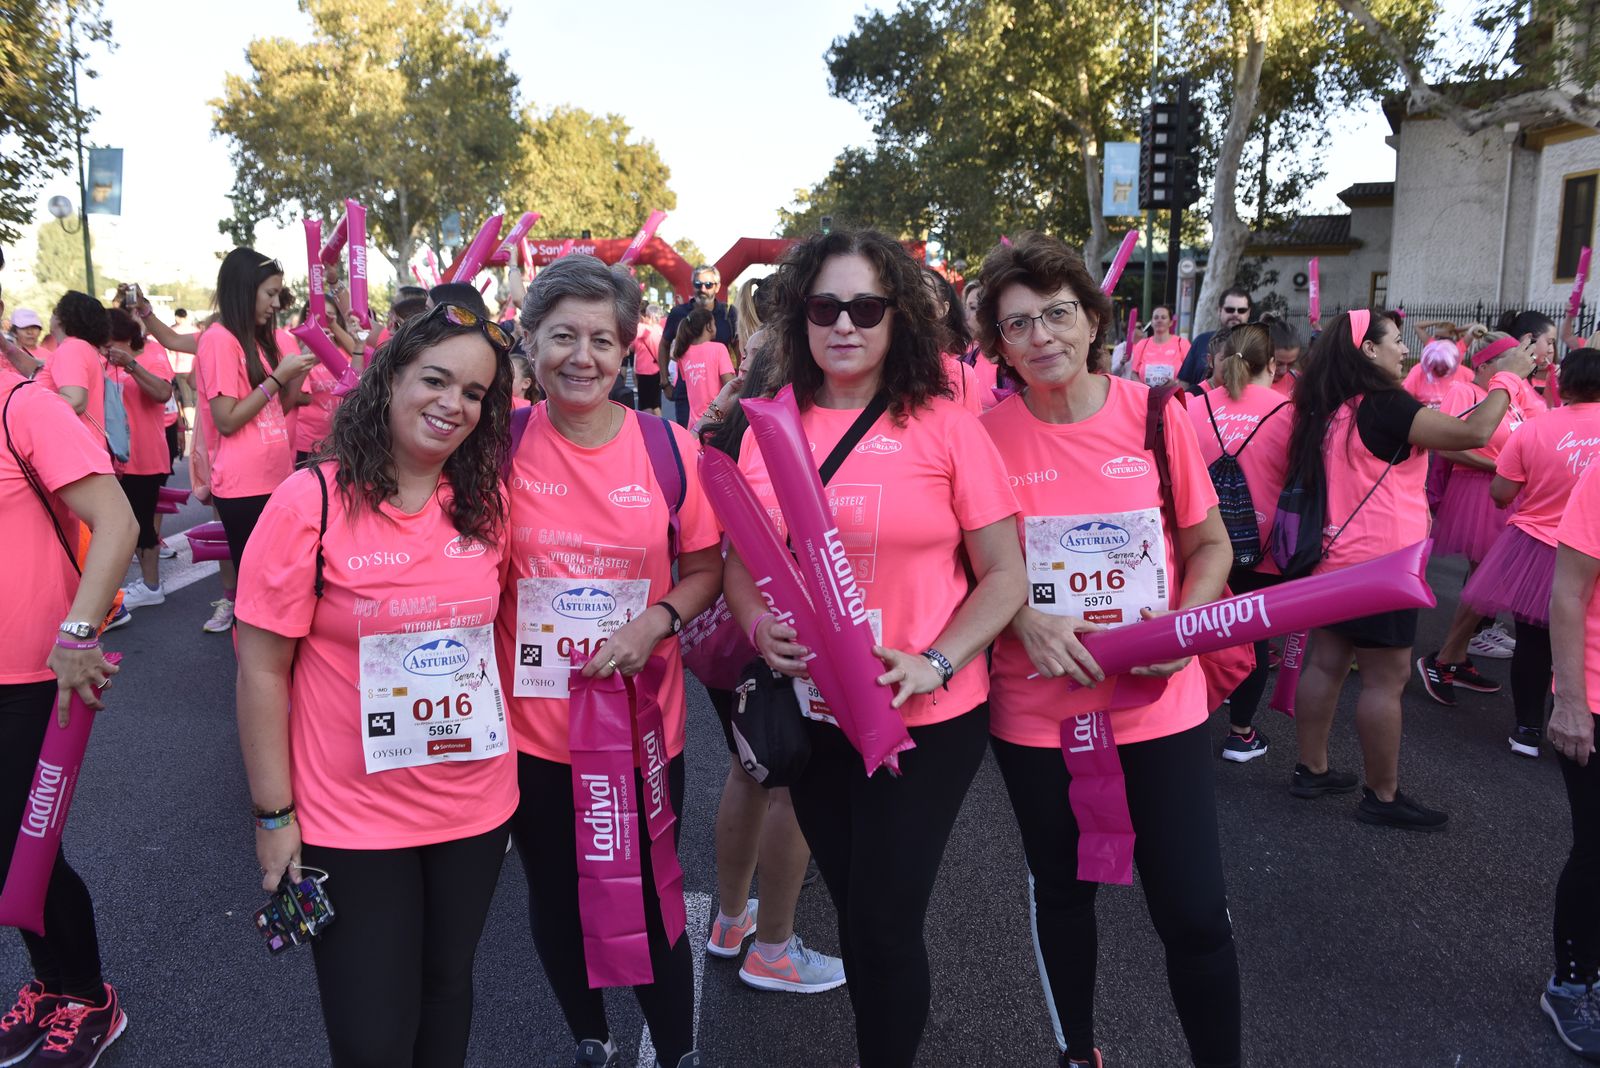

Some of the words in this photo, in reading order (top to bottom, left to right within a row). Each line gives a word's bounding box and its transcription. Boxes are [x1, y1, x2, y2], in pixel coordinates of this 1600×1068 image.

[539, 244, 596, 255] Santnder
[513, 477, 568, 496] OYSHO
[1066, 534, 1125, 547] ASTURIANA
[348, 551, 410, 570] OYSHO
[550, 552, 585, 565] VITORIA
[593, 557, 631, 569] GASTEIZ
[823, 527, 870, 626] Ladival
[1069, 569, 1126, 593] 016
[556, 598, 613, 612] ASTURIANA
[1084, 595, 1113, 607] 5970
[1175, 594, 1271, 649] Ladival
[409, 653, 466, 670] ASTURIANA
[521, 678, 555, 688] OYSHO
[412, 692, 472, 721] 016
[428, 723, 461, 736] 5967
[372, 747, 412, 760] OYSHO
[643, 730, 662, 819] Ladival
[21, 758, 63, 838] Ladival
[581, 774, 614, 862] Ladival
